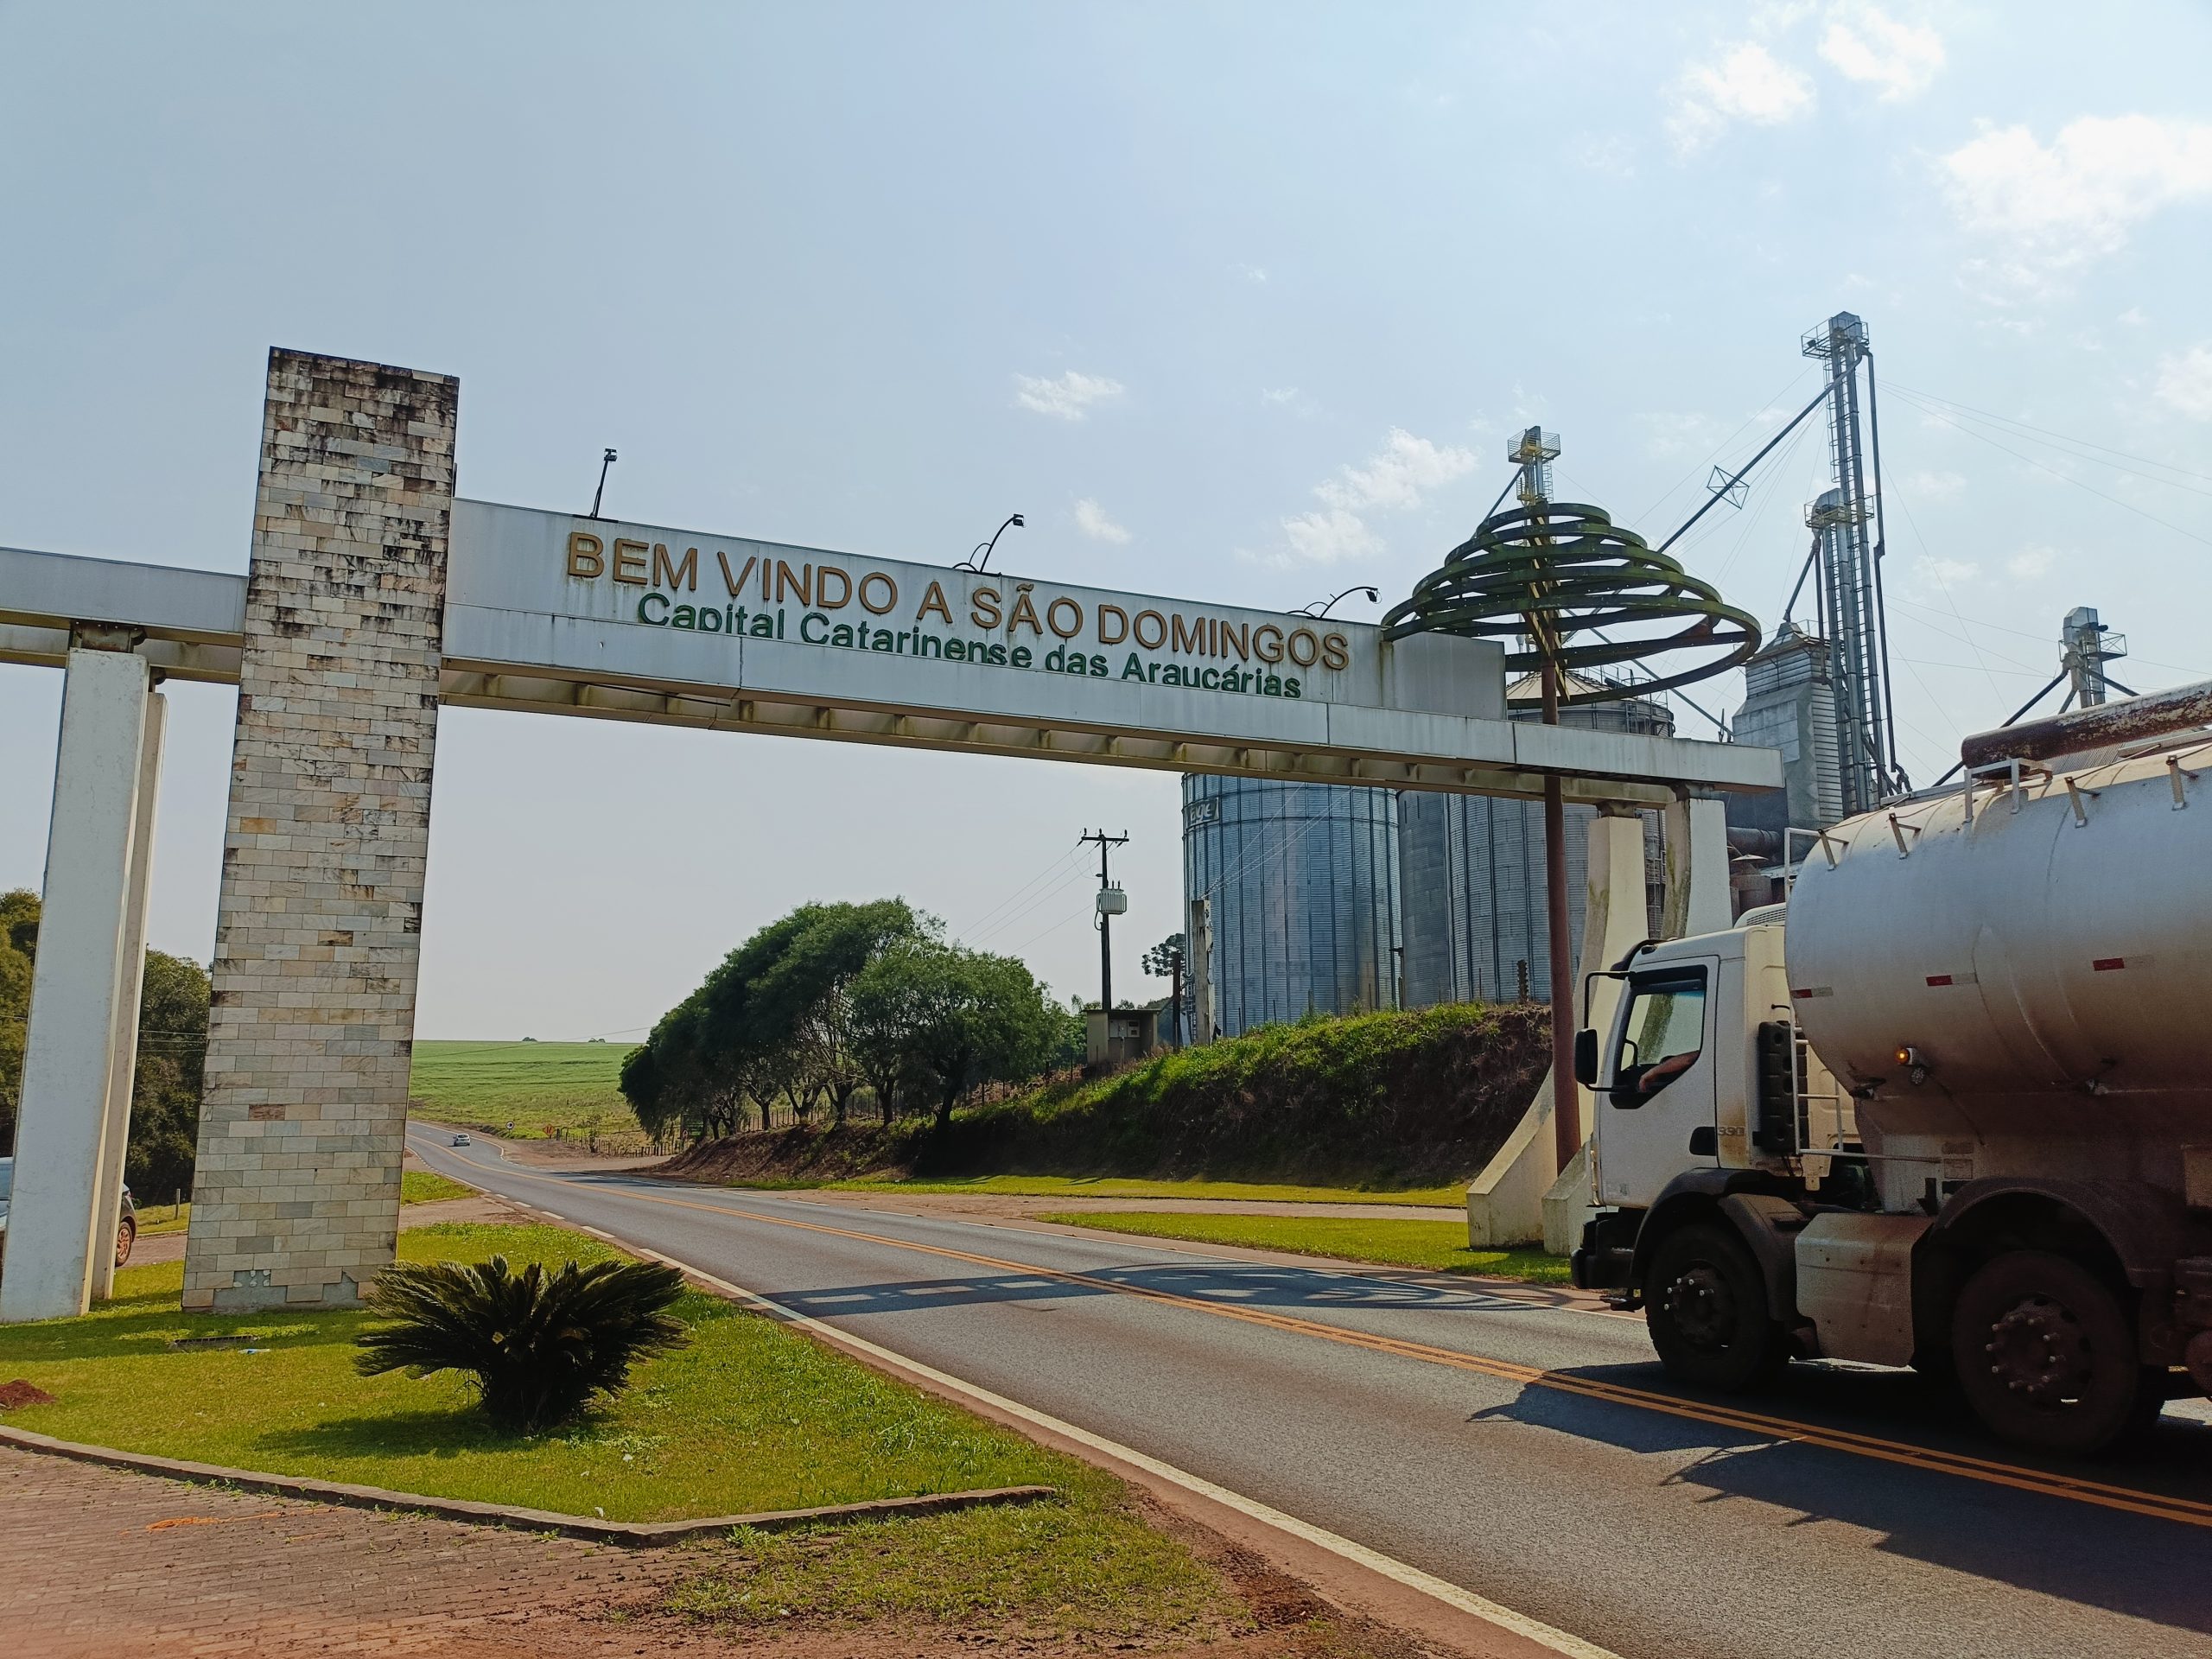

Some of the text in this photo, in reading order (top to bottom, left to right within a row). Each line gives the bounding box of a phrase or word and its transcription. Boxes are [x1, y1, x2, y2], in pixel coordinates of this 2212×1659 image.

[567, 532, 1349, 670] BEM VINDO A SÃO DOMINGOS
[639, 593, 1301, 699] Capital Catarinense das Araucárias
